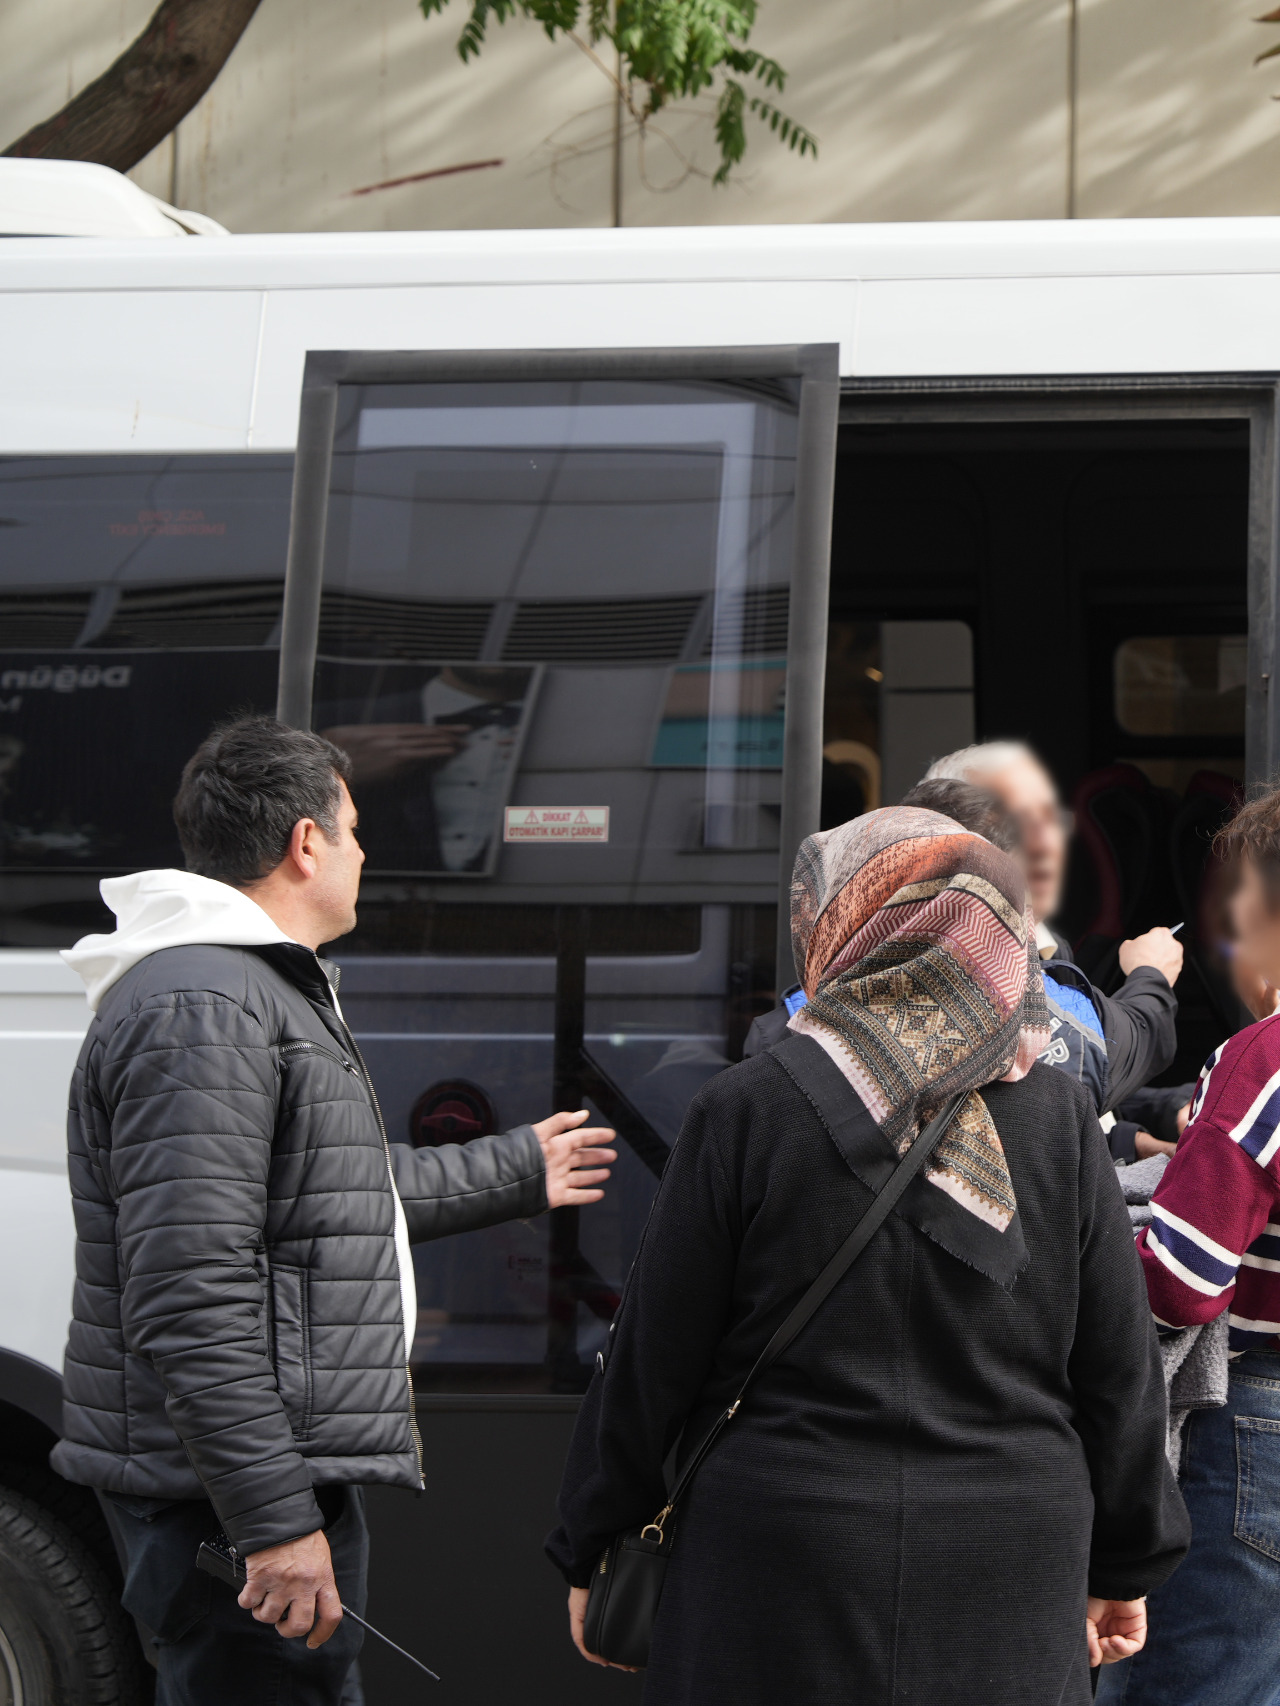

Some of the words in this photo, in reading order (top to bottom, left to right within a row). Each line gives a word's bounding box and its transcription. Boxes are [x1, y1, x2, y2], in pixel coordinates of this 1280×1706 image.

[542, 810, 572, 822] DİKKAT
[509, 825, 549, 837] OTOMATİK
[551, 826, 569, 837] KAPI
